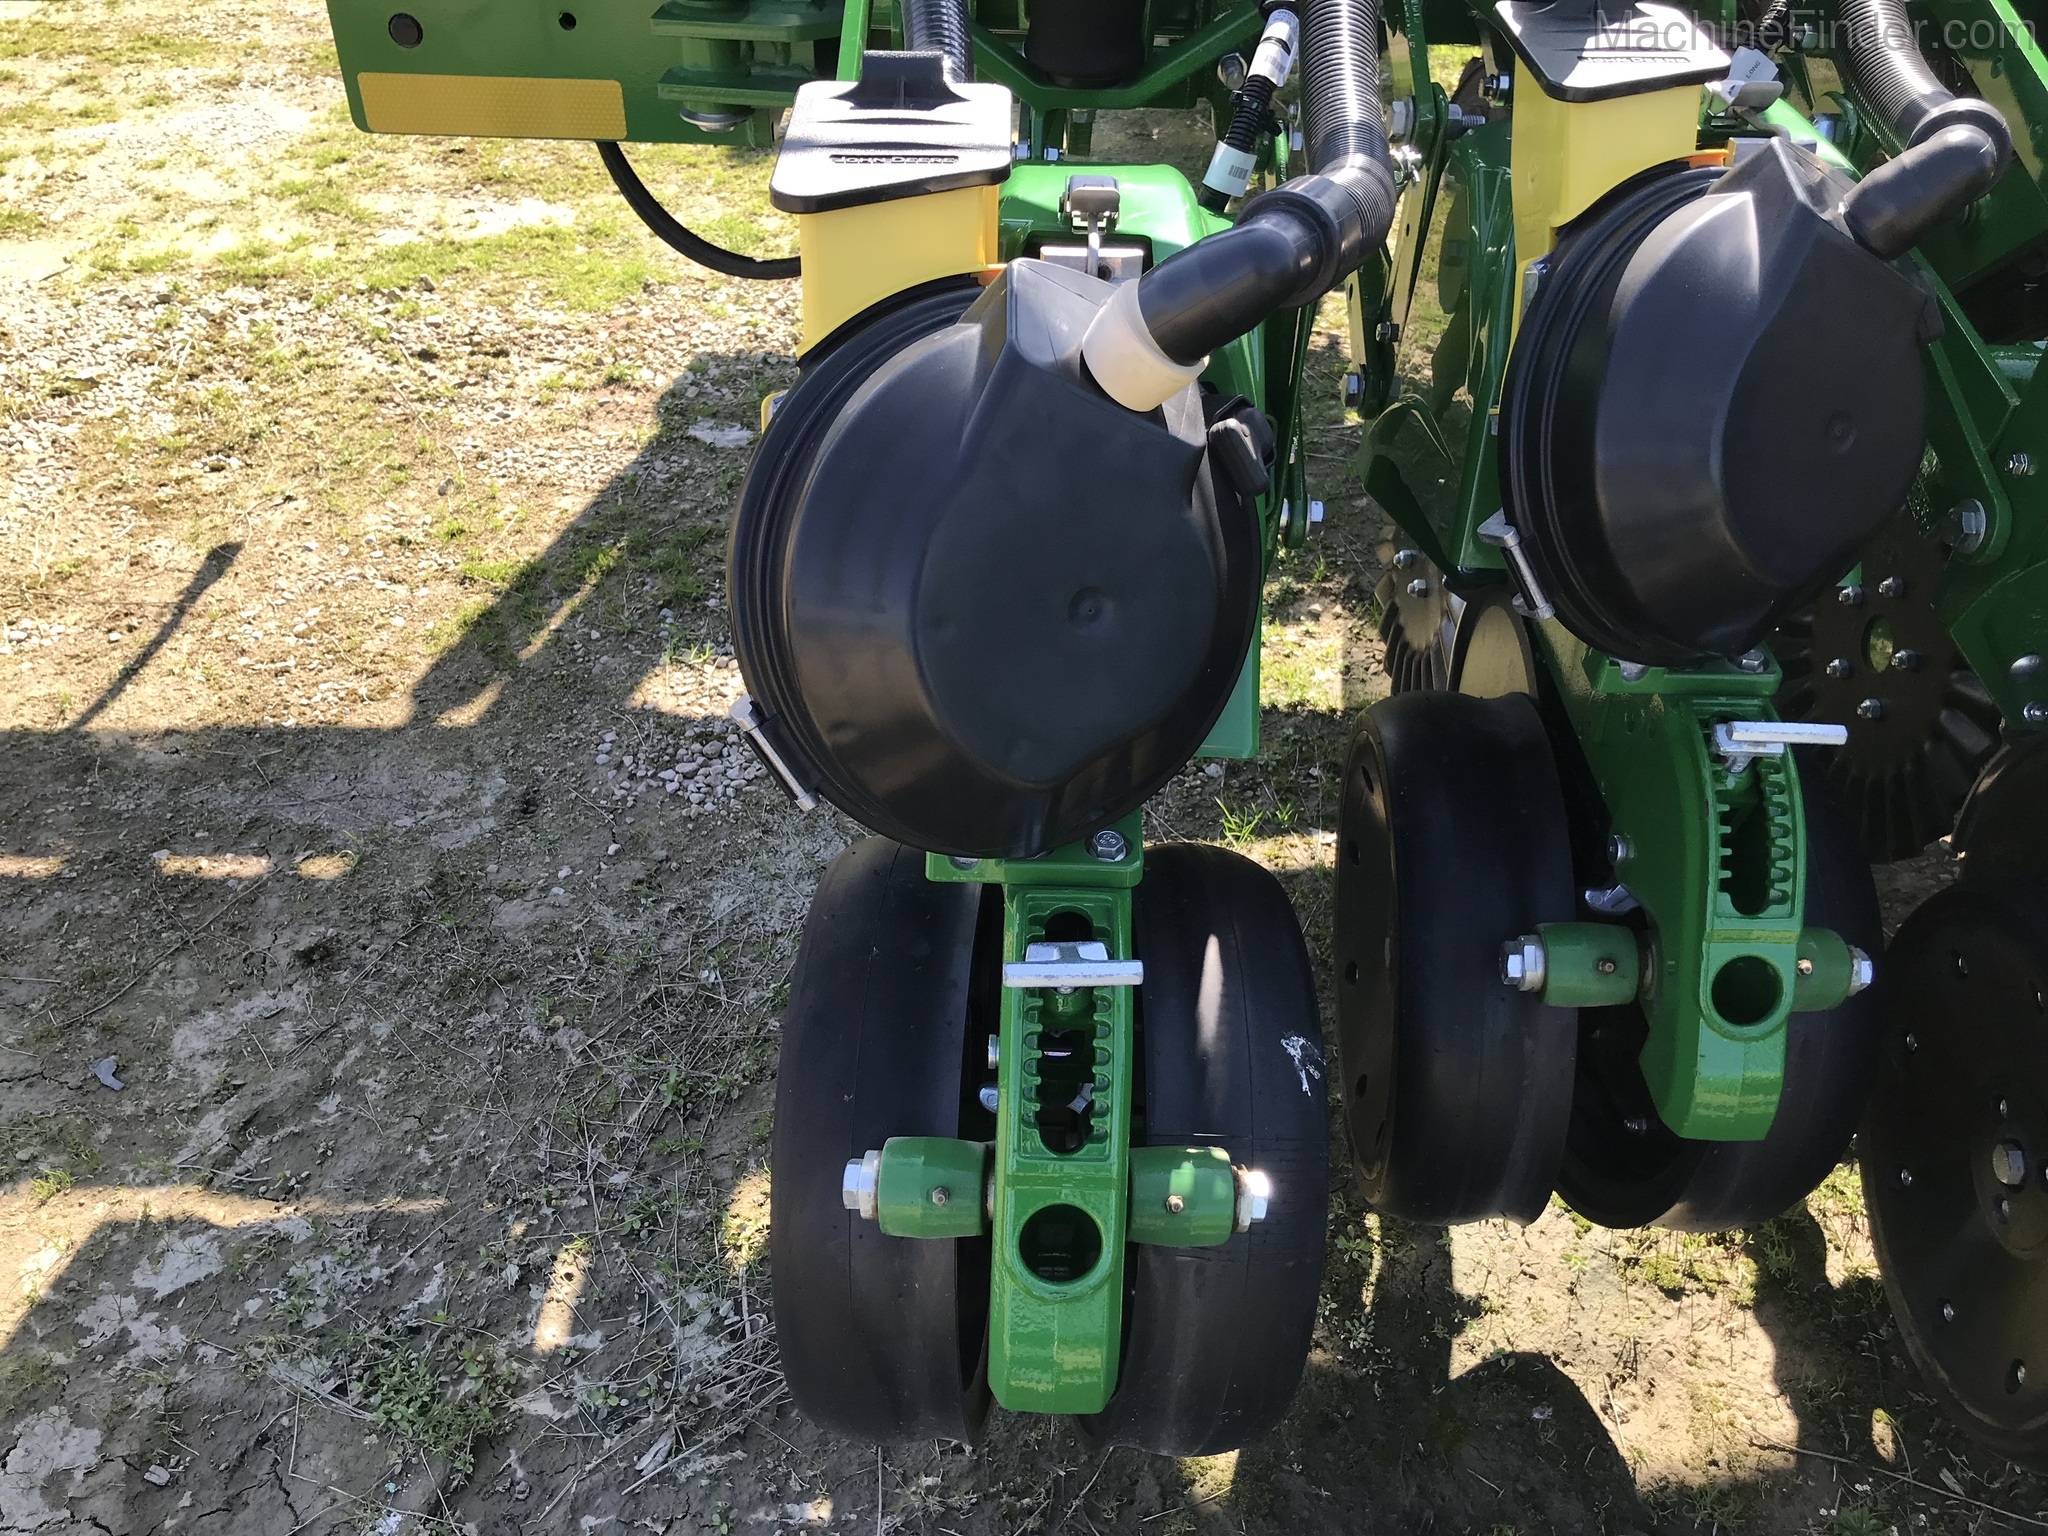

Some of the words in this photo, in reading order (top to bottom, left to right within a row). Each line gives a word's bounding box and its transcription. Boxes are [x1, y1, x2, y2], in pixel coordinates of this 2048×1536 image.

[1745, 60, 1761, 79] LONG
[832, 155, 887, 164] JOHN
[889, 155, 957, 165] DEERE
